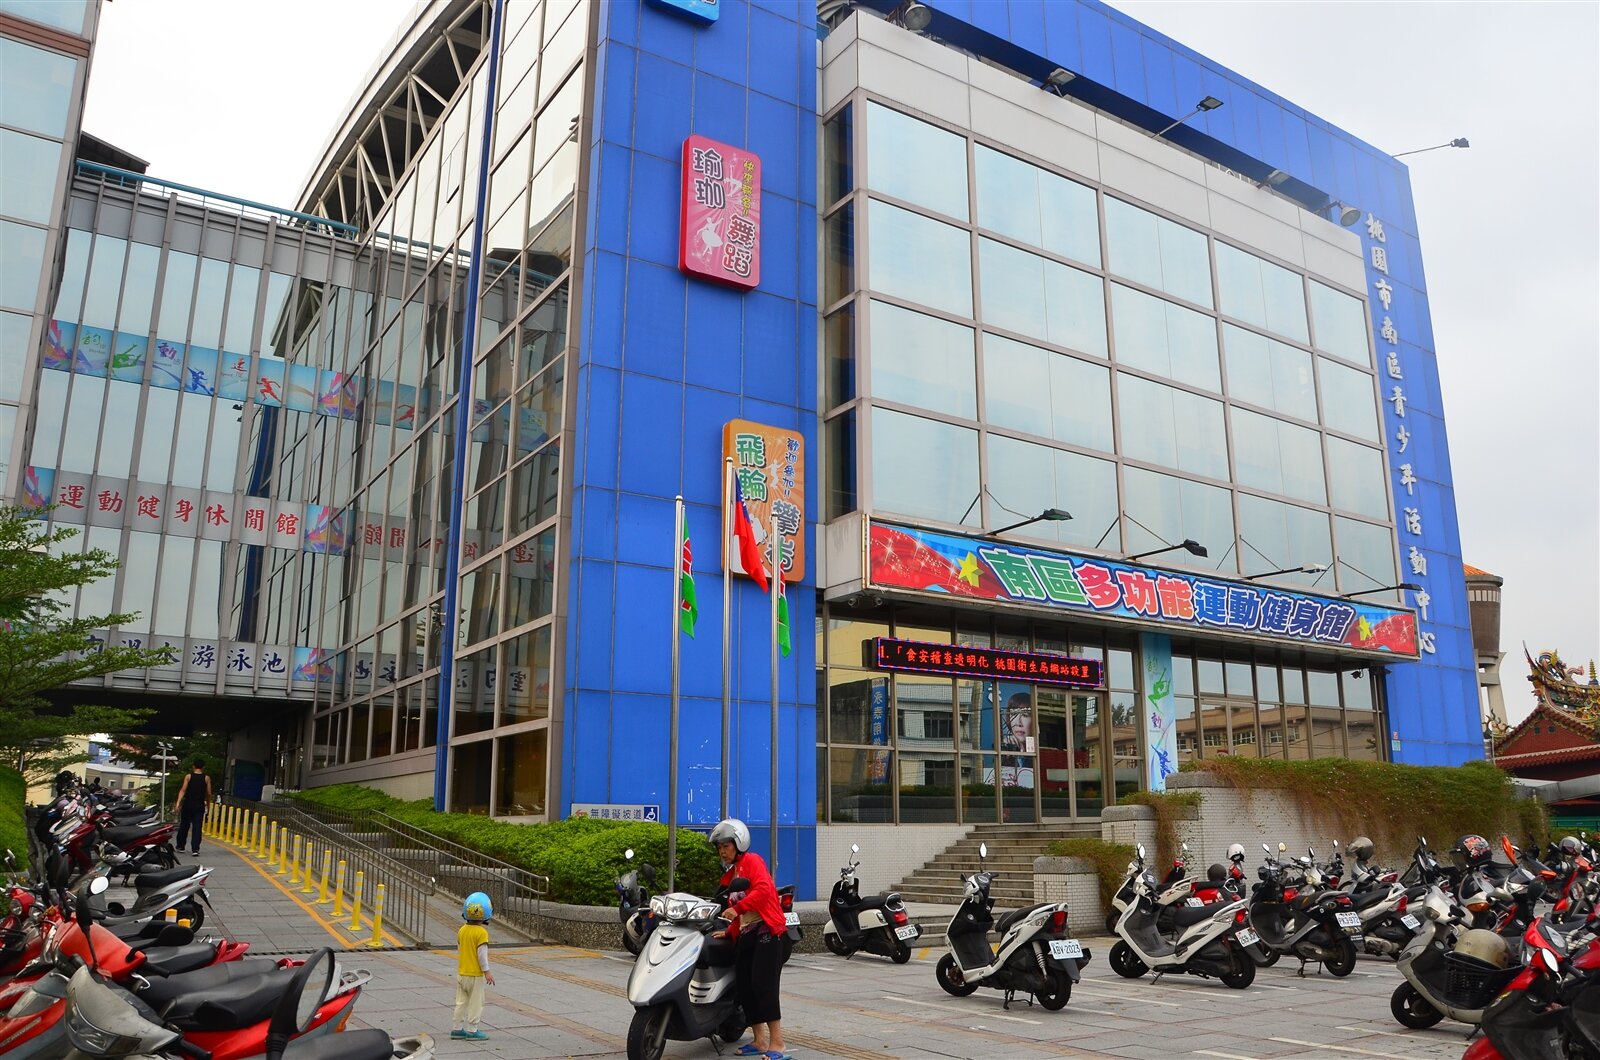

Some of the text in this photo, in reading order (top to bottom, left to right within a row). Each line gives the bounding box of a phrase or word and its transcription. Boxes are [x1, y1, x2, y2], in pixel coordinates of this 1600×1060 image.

[693, 148, 725, 209] 瑜珈
[722, 213, 756, 277] 舞蹈
[1365, 212, 1436, 654] 桃園市南區青少年活動中心
[736, 433, 767, 502] 飛輪
[59, 484, 300, 536] 運動健身休閒館
[979, 548, 1354, 643] 南區多功能運動健身館
[590, 808, 641, 819] 無障礙坡道
